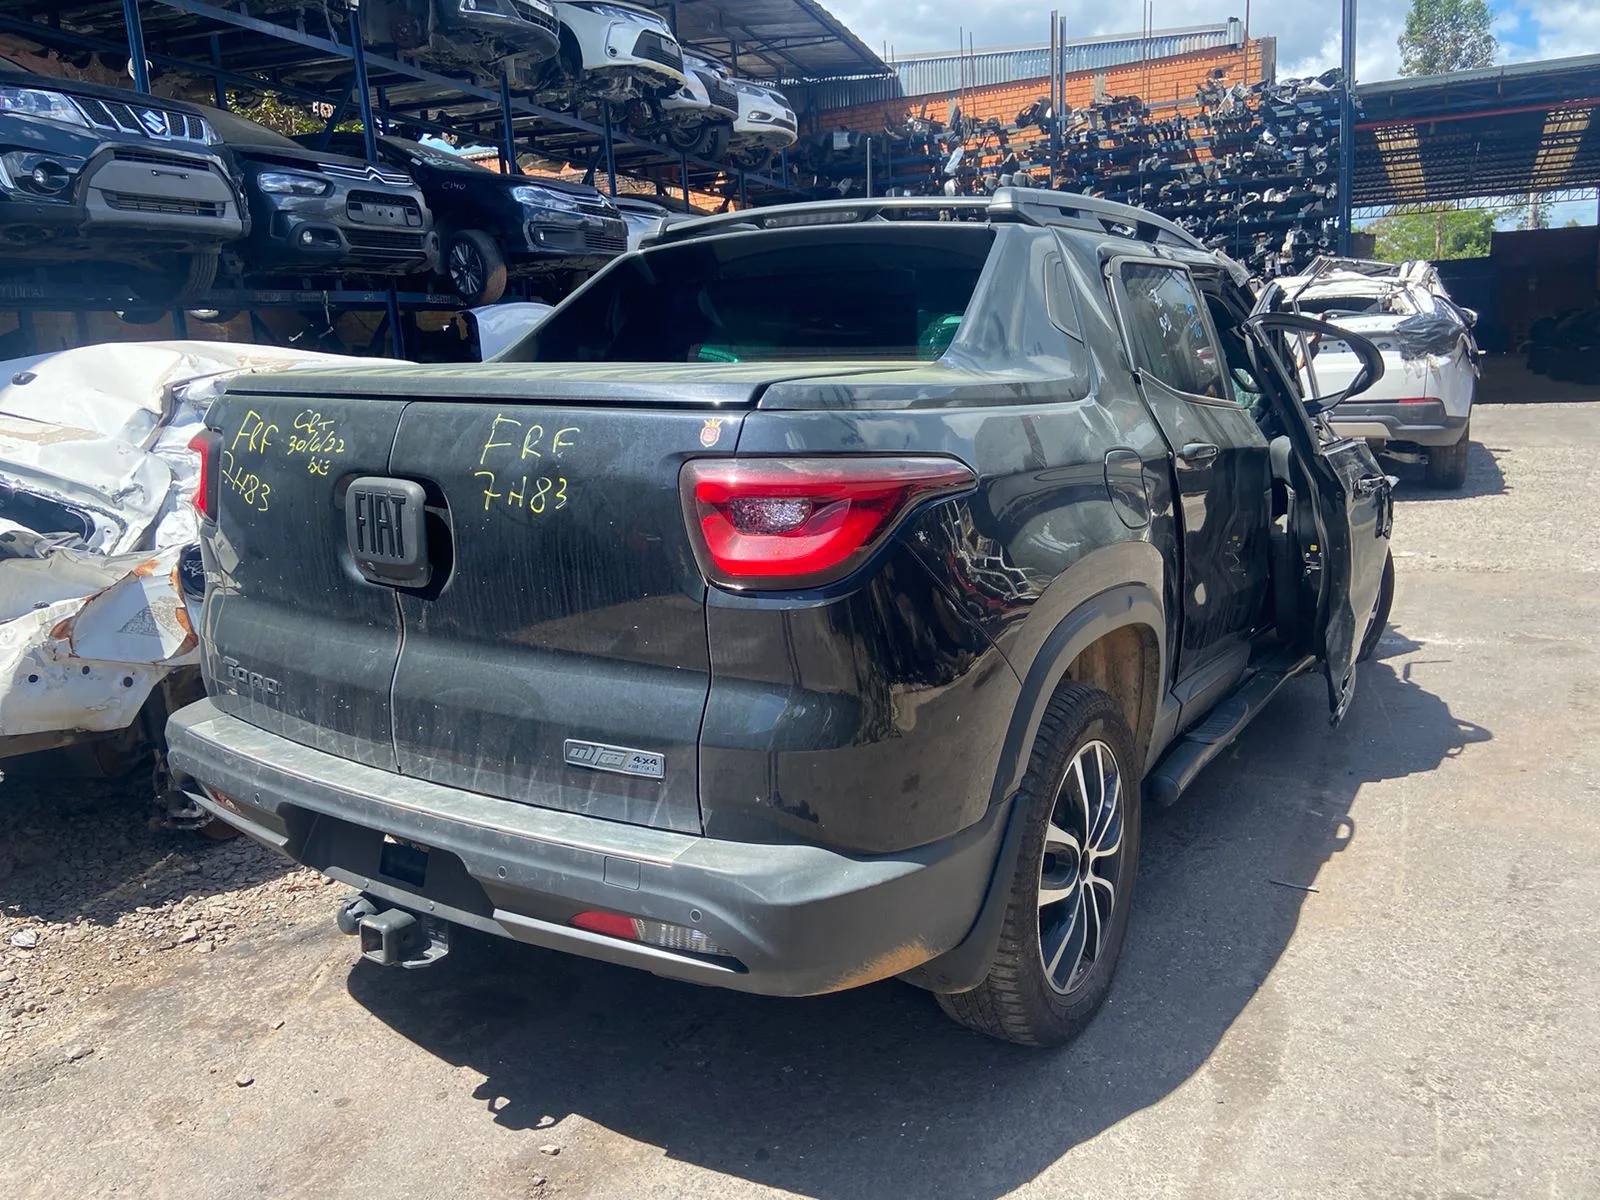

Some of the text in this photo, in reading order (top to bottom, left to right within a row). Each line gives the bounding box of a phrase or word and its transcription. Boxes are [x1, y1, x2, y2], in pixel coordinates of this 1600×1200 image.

[287, 430, 345, 456] 30/6/22
[479, 412, 581, 465] FRF
[354, 490, 407, 559] FIAT
